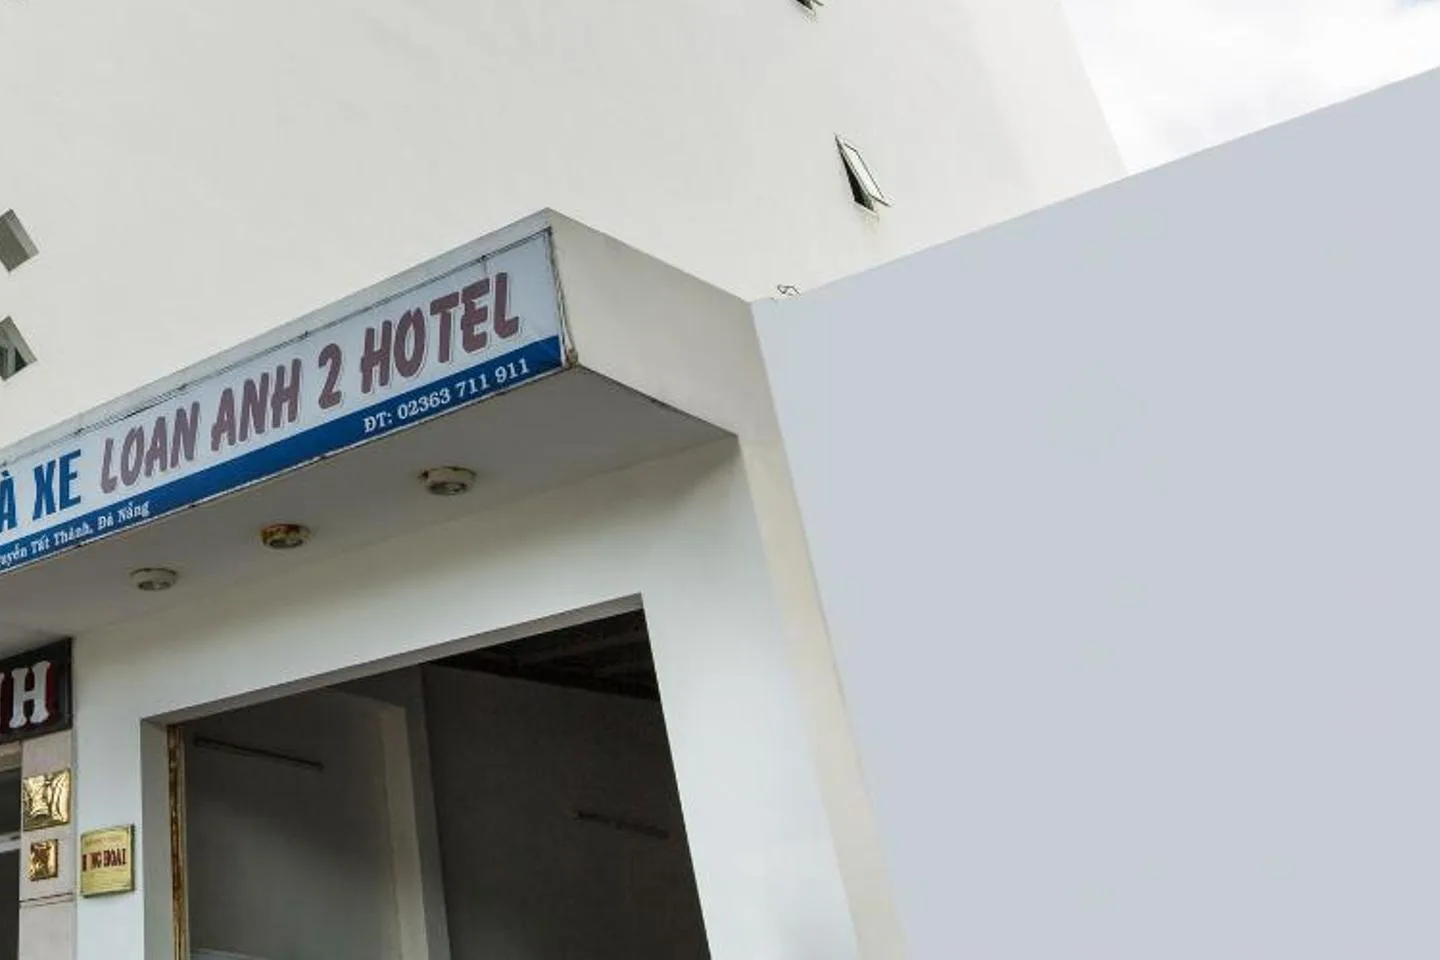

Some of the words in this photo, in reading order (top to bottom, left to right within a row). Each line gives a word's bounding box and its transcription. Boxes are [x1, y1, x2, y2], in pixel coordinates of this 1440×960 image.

[32, 448, 82, 521] XE
[100, 401, 201, 494] LOAN
[210, 358, 302, 452] ANH
[317, 342, 343, 410] 2
[360, 271, 520, 394] HOTEL
[363, 411, 393, 433] ĐT:
[397, 387, 451, 420] 02363
[454, 372, 490, 398] 711
[494, 357, 531, 383] 911
